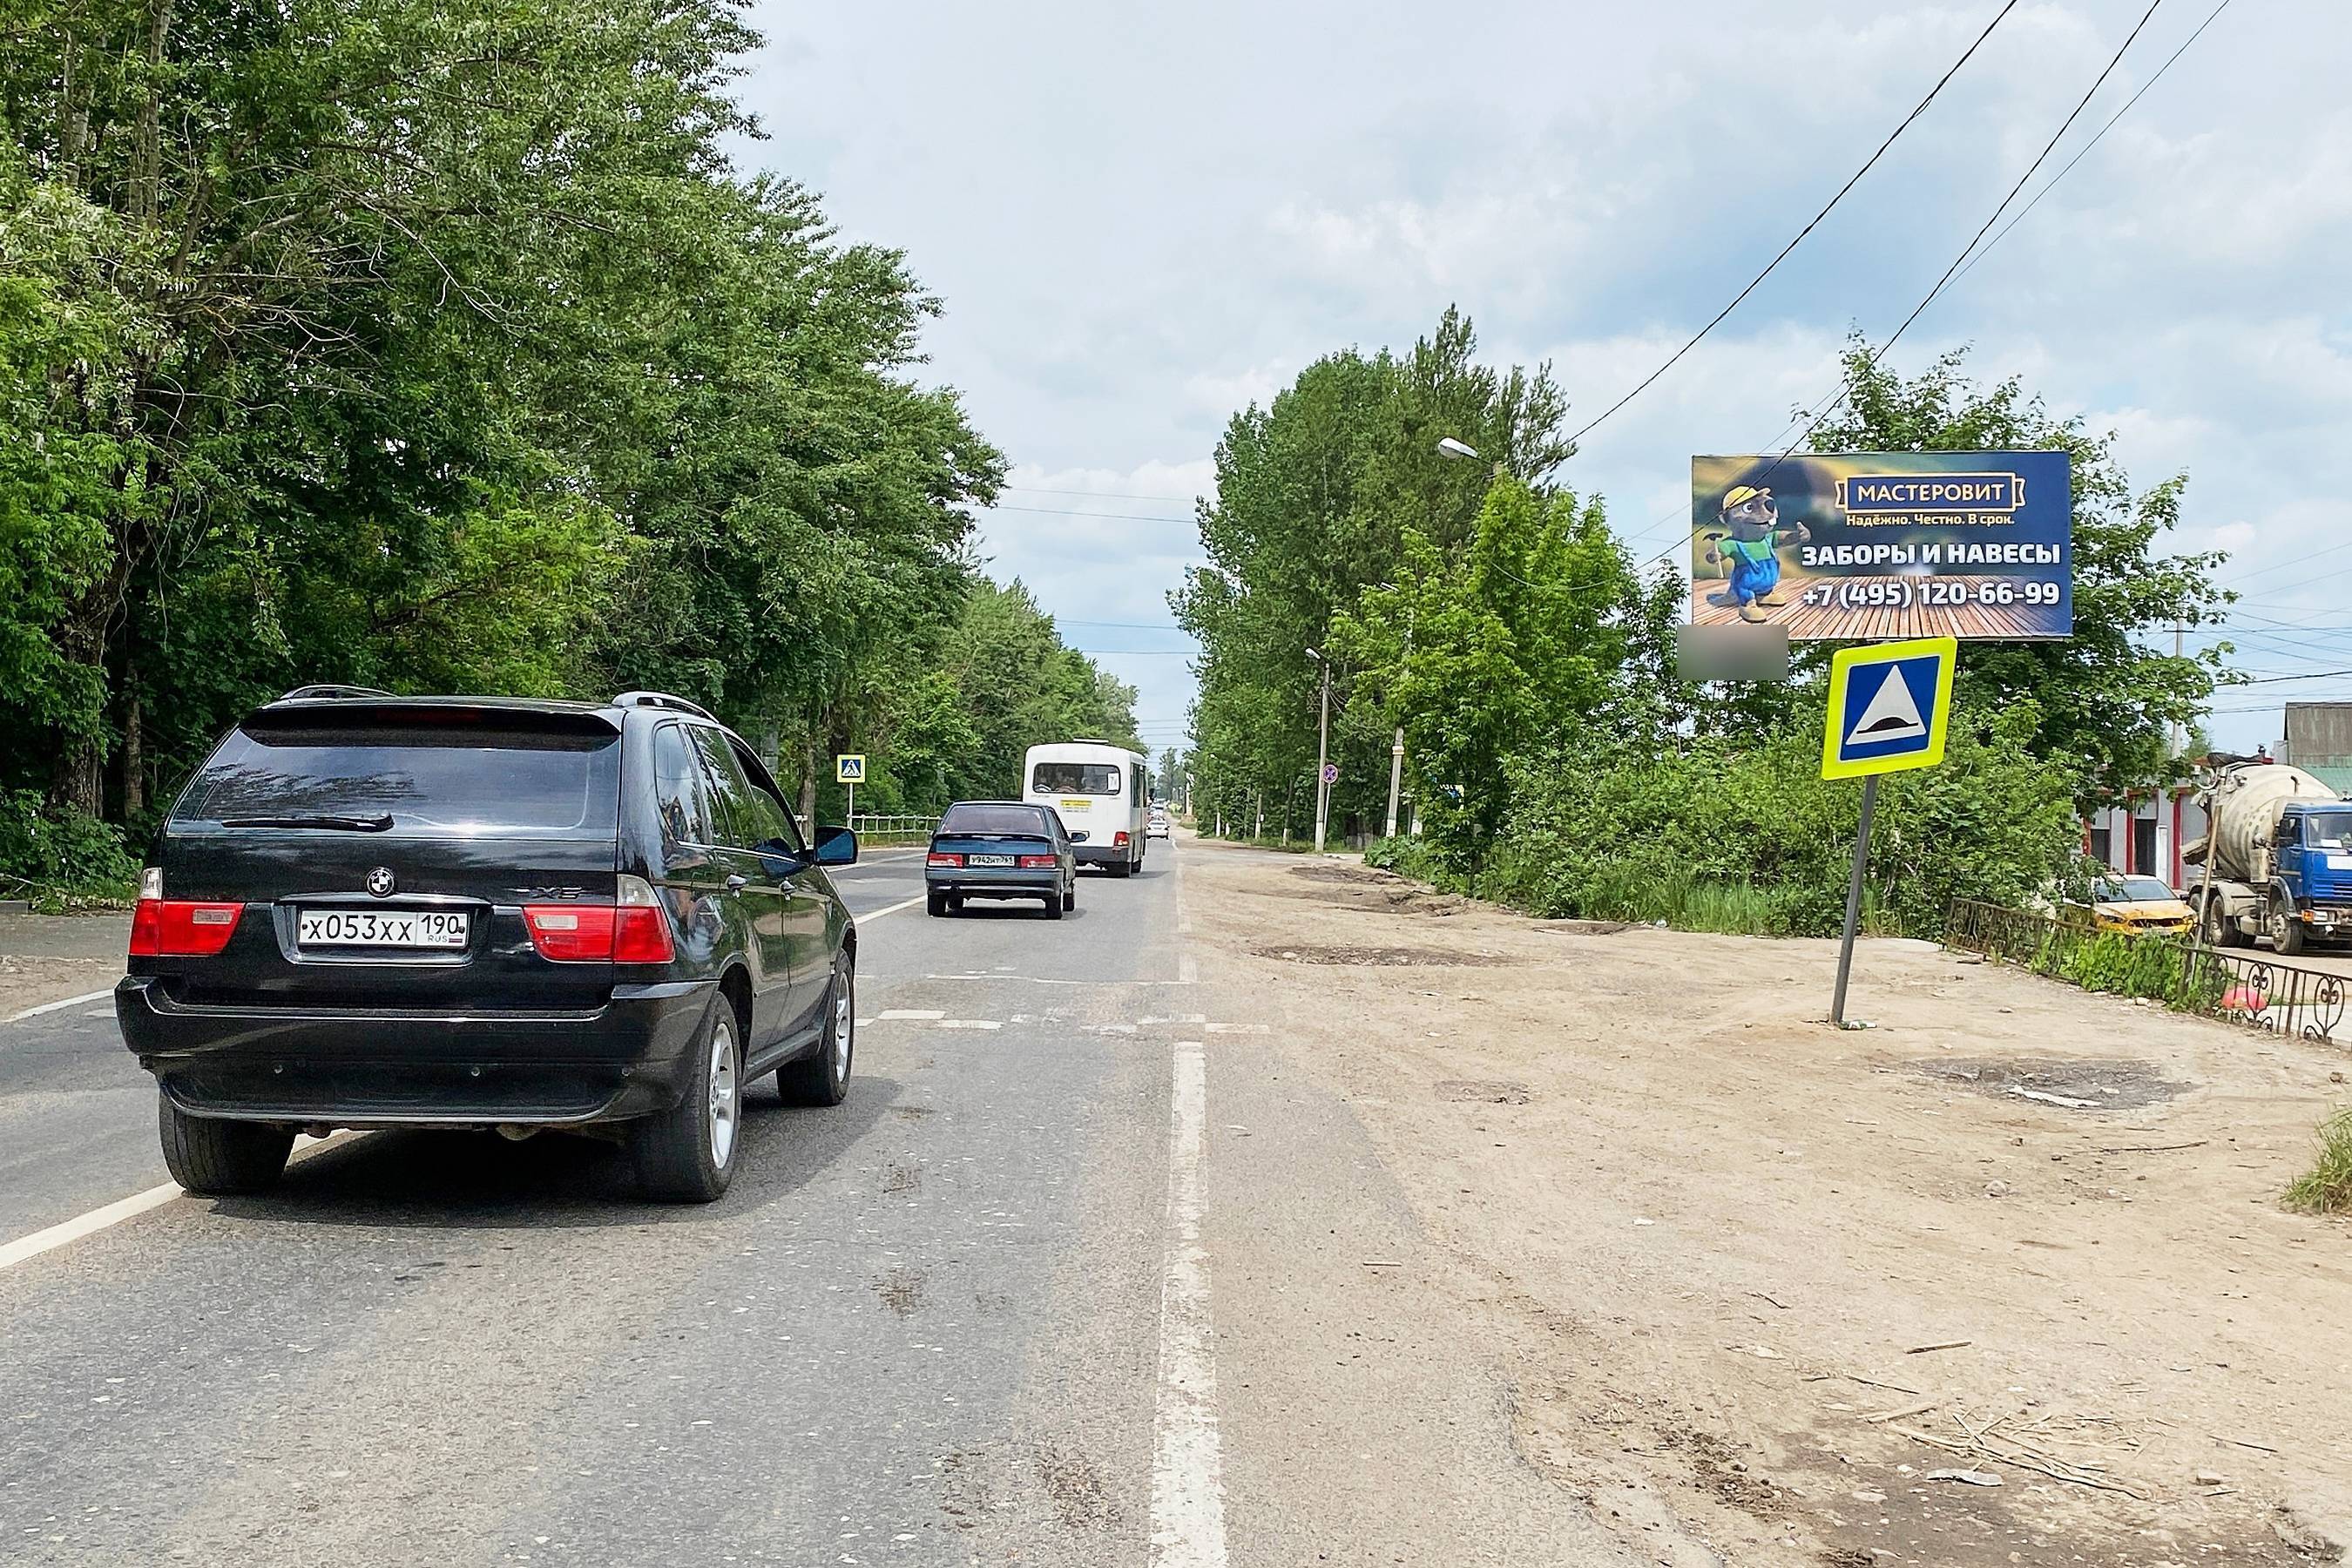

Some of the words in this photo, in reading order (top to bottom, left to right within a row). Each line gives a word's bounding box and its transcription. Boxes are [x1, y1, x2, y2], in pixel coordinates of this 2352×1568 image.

[1857, 483, 2005, 503] МАСТЕРОВИТ
[1846, 514, 1912, 528] Надёжно.
[1914, 513, 1965, 525] Честно.
[1968, 512, 1977, 524] В
[1979, 514, 2015, 528] срок.
[1801, 544, 1916, 566] ЗАБОРЫ
[1923, 544, 1941, 564] И
[1948, 544, 2060, 564] НАВЕСЫ
[1802, 585, 1834, 606] +7
[1839, 581, 1913, 609] (495)
[1916, 582, 2060, 605] 120-66-99
[421, 915, 459, 935] 190
